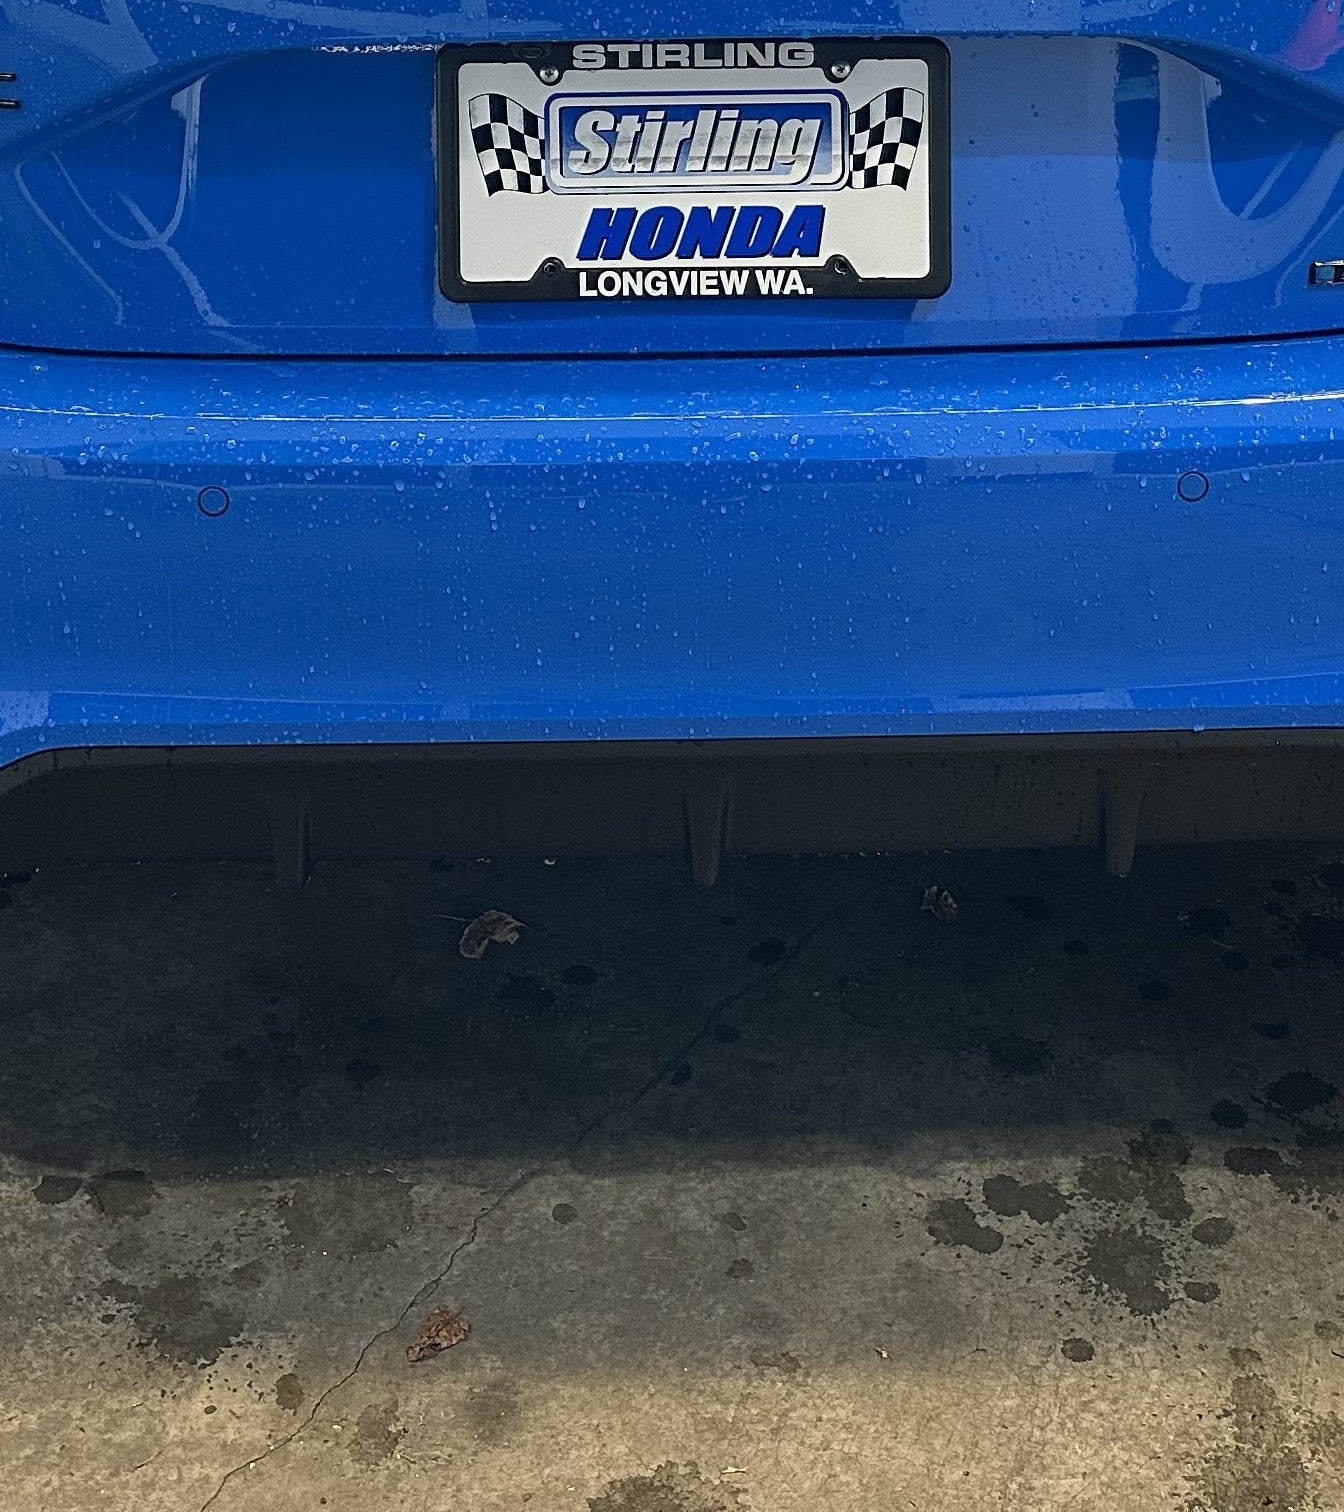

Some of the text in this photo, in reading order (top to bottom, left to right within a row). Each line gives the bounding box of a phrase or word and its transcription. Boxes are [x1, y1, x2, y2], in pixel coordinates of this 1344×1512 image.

[572, 41, 816, 70] STIRLING
[568, 109, 824, 186] Stirling
[575, 204, 826, 262] HONDA
[578, 268, 814, 297] LONGVIEW WA.
